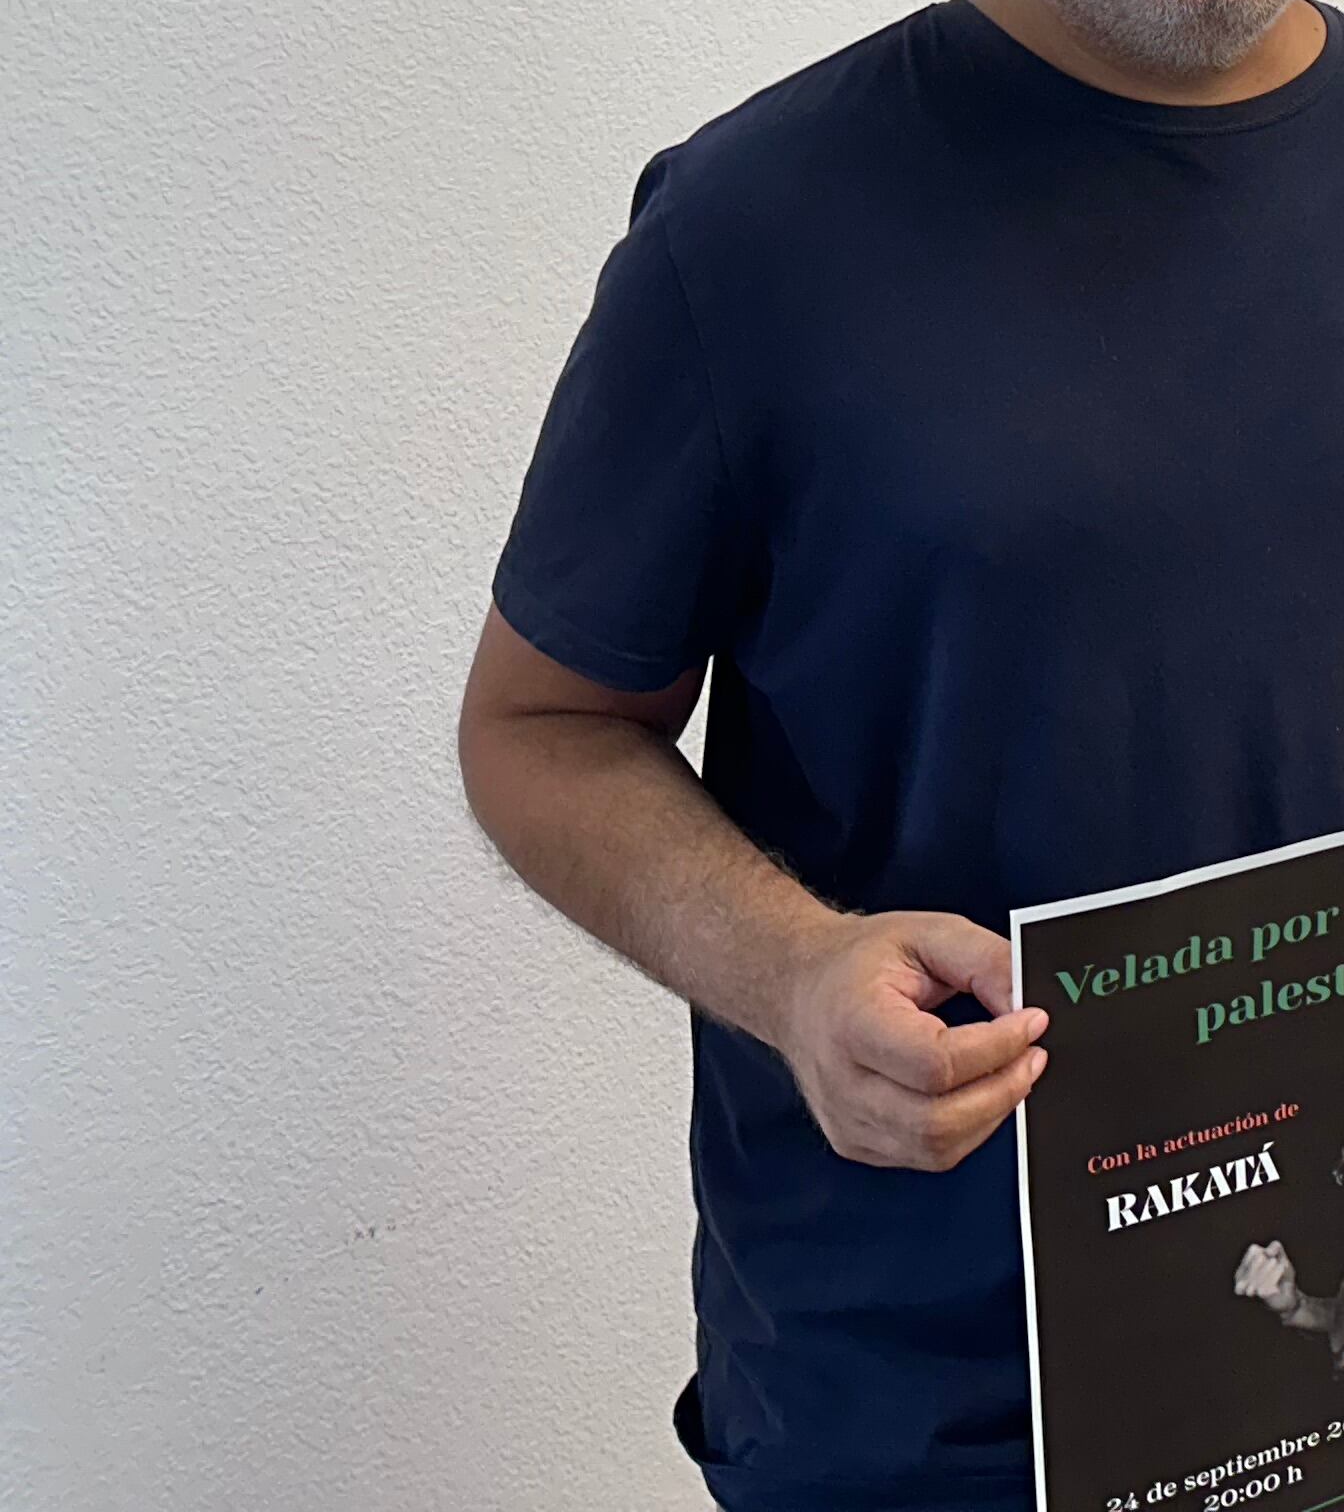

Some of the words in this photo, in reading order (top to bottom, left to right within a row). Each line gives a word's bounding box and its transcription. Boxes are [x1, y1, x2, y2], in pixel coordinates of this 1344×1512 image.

[1056, 935, 1234, 1005] Velada
[1251, 905, 1340, 961] por
[1087, 1151, 1131, 1175] Con
[1136, 1144, 1158, 1161] la
[1163, 1111, 1269, 1154] actuación
[1274, 1103, 1300, 1122] de
[1106, 1141, 1281, 1232] RAKATÁ
[1106, 1492, 1139, 1512] 24
[1146, 1481, 1177, 1504] de
[1184, 1431, 1321, 1491] septiembre
[1203, 1473, 1281, 1512] 20:00
[1287, 1465, 1304, 1485] h
